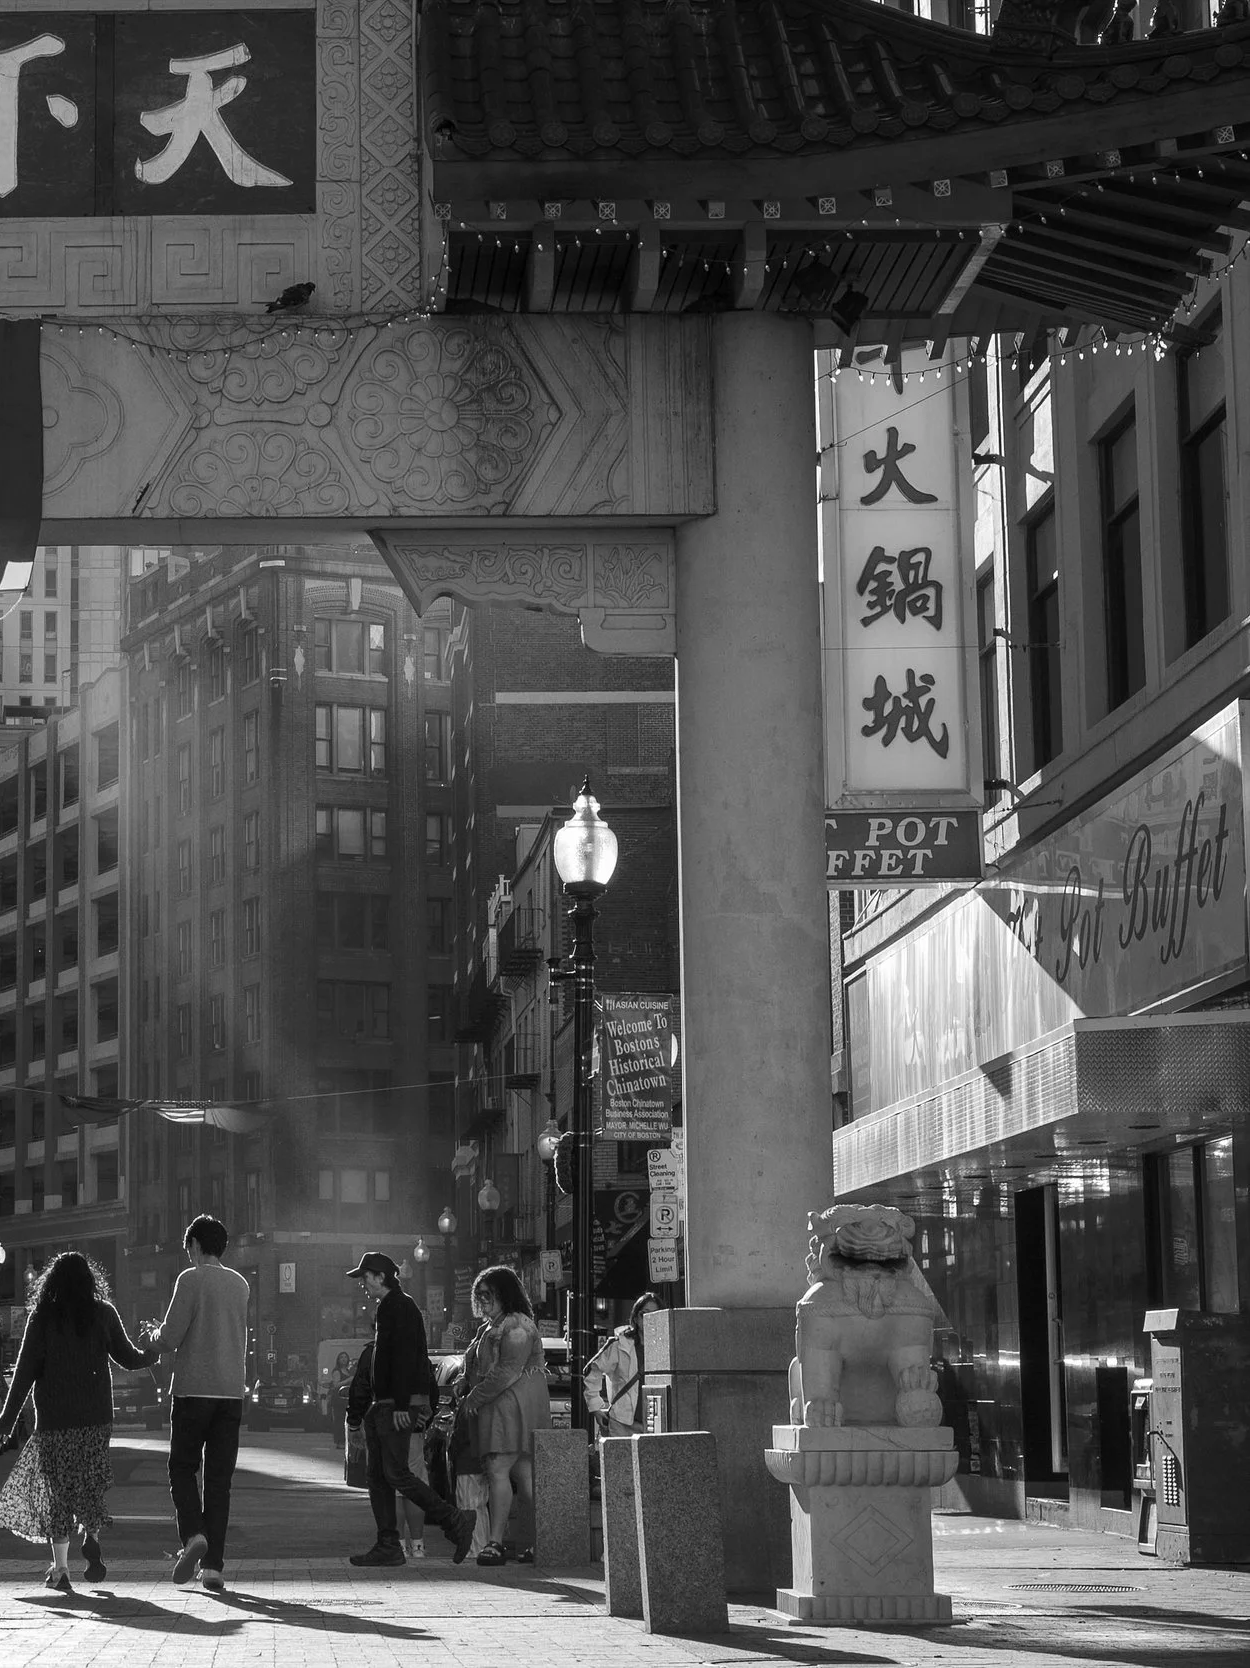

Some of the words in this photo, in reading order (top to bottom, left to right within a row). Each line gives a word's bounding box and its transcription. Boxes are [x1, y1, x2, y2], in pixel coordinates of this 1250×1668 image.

[855, 346, 950, 760] 火鍋城
[865, 816, 959, 847] POT
[1056, 866, 1106, 982] Pot
[1119, 790, 1230, 965] Buffet
[615, 1001, 639, 1010] ASIAN
[639, 1001, 669, 1010] CUISINE
[605, 1018, 653, 1038] Welcome
[654, 1012, 668, 1029] To
[608, 1050, 666, 1076] Historical
[606, 1074, 667, 1096] Chinatown
[609, 1098, 632, 1107] Boston
[632, 1098, 665, 1107] Chinatown
[605, 1108, 633, 1118] Business
[634, 1109, 669, 1118] Association
[628, 1121, 658, 1130] MICHELLE
[658, 1121, 669, 1130] WU
[613, 1131, 627, 1139] CITY
[627, 1131, 636, 1139] OF
[636, 1131, 661, 1139] BOSTON
[649, 1170, 676, 1178] Cleaning
[650, 1246, 676, 1254] Parking
[658, 1255, 675, 1263] Hour
[655, 1265, 673, 1273] Limit
